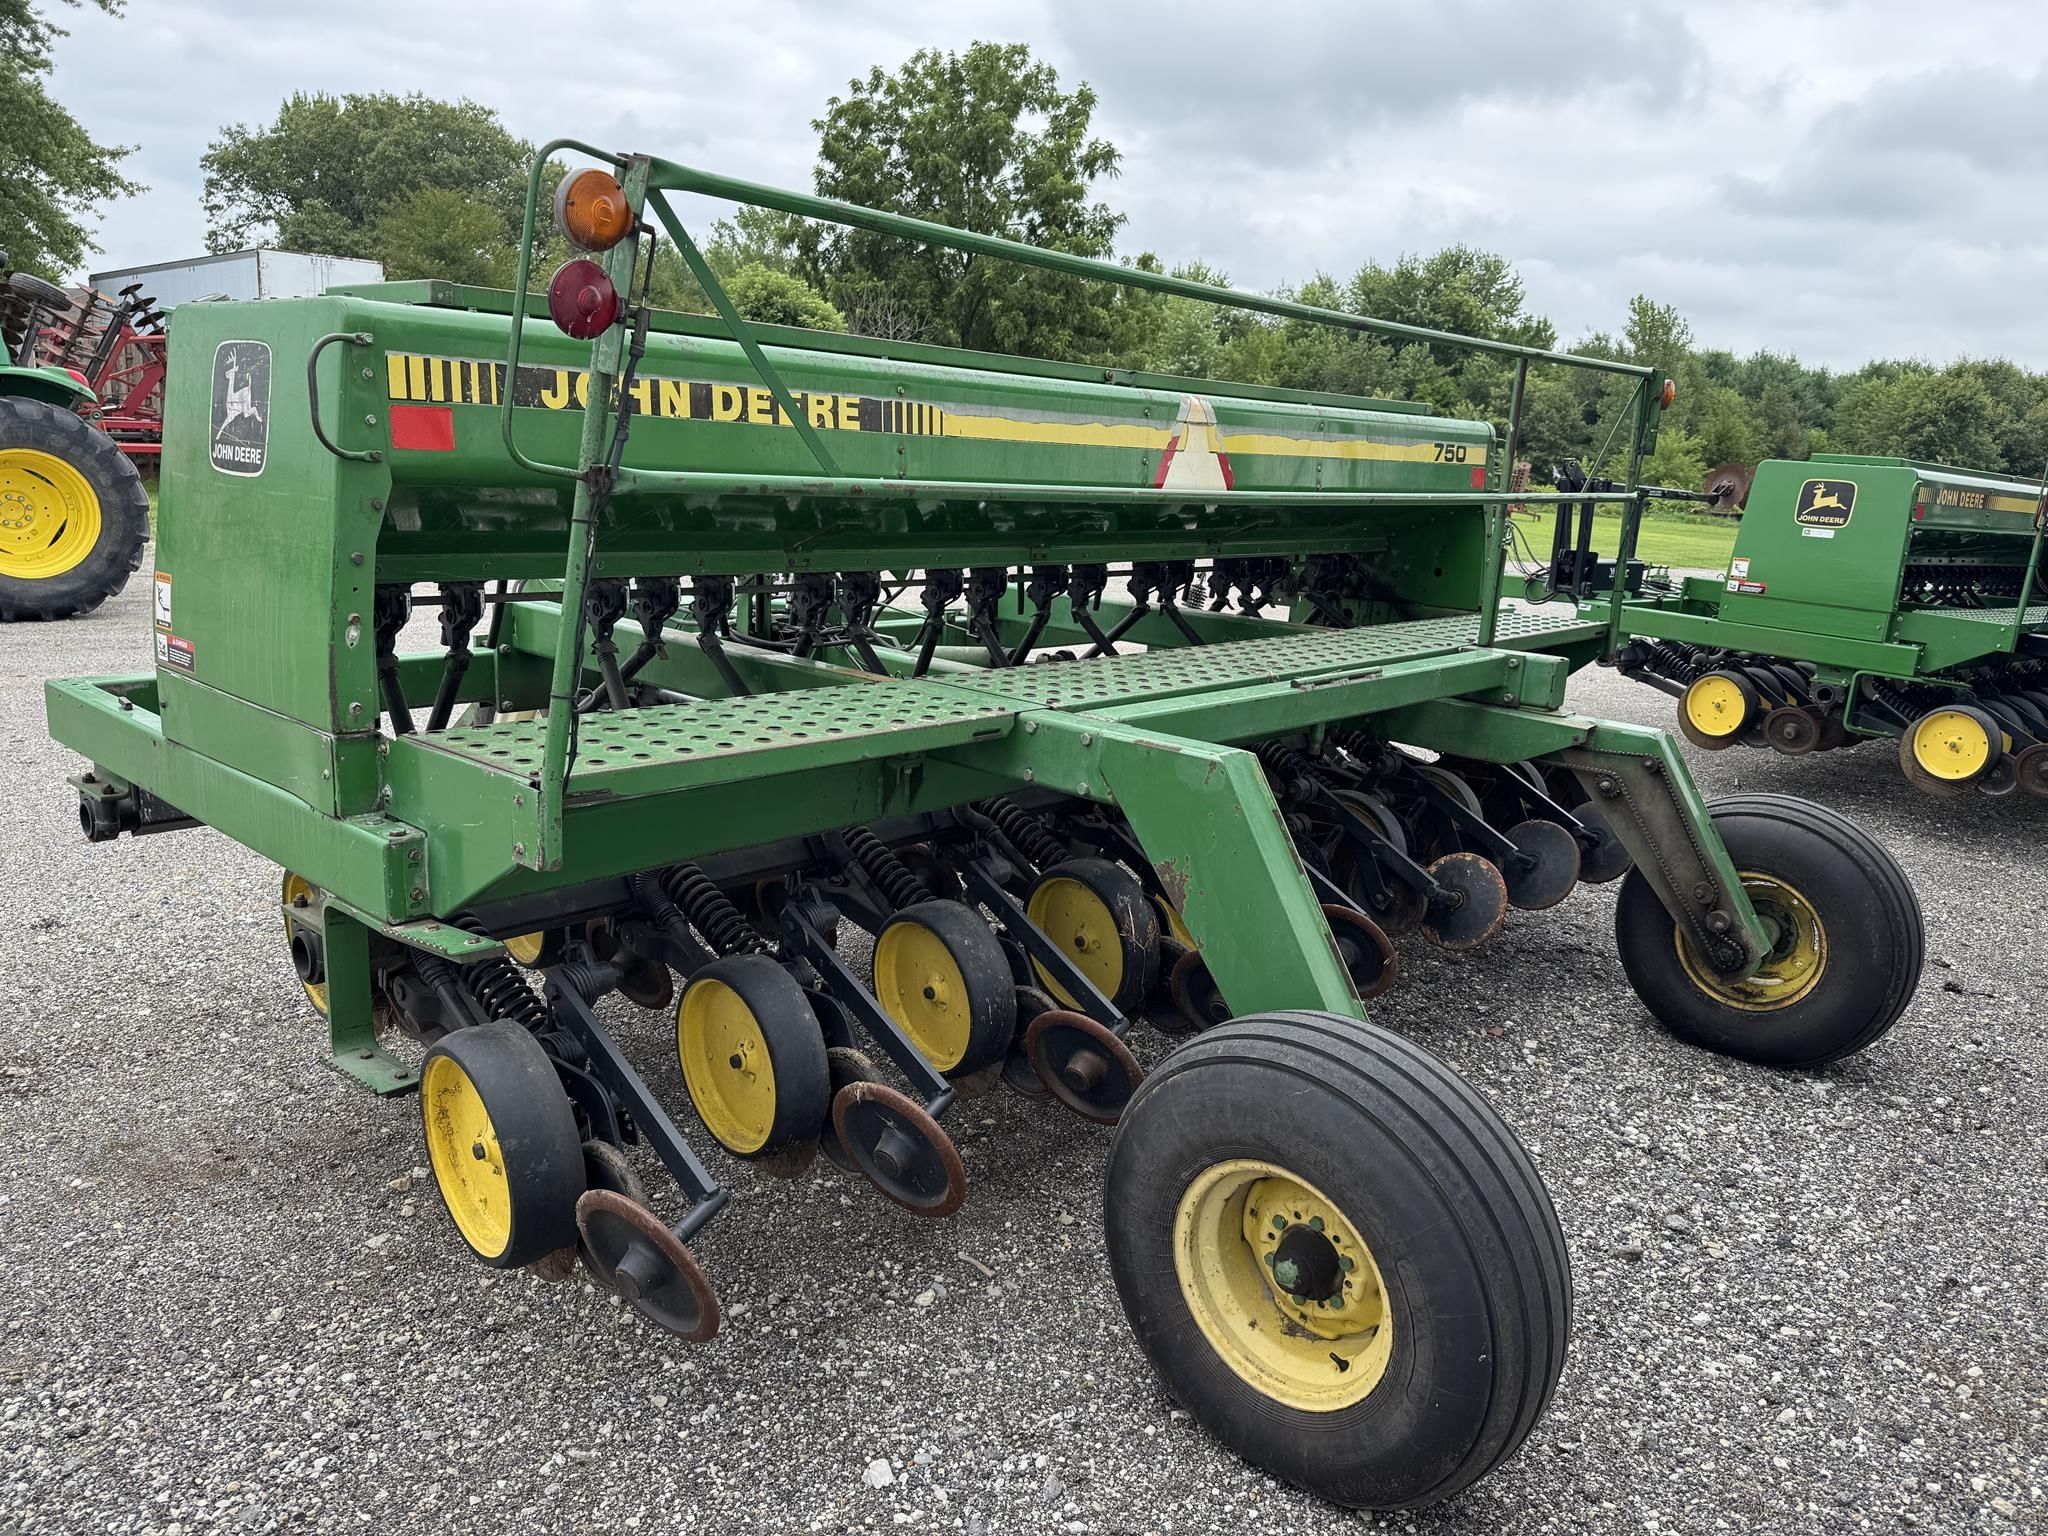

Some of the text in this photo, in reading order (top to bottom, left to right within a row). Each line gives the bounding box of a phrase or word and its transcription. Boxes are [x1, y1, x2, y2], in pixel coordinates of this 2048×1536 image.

[212, 443, 262, 465] JOHN DEERE
[1434, 442, 1467, 463] 750
[1936, 487, 1985, 509] JOHN DEERE
[1798, 514, 1846, 525] JOHN DEERE
